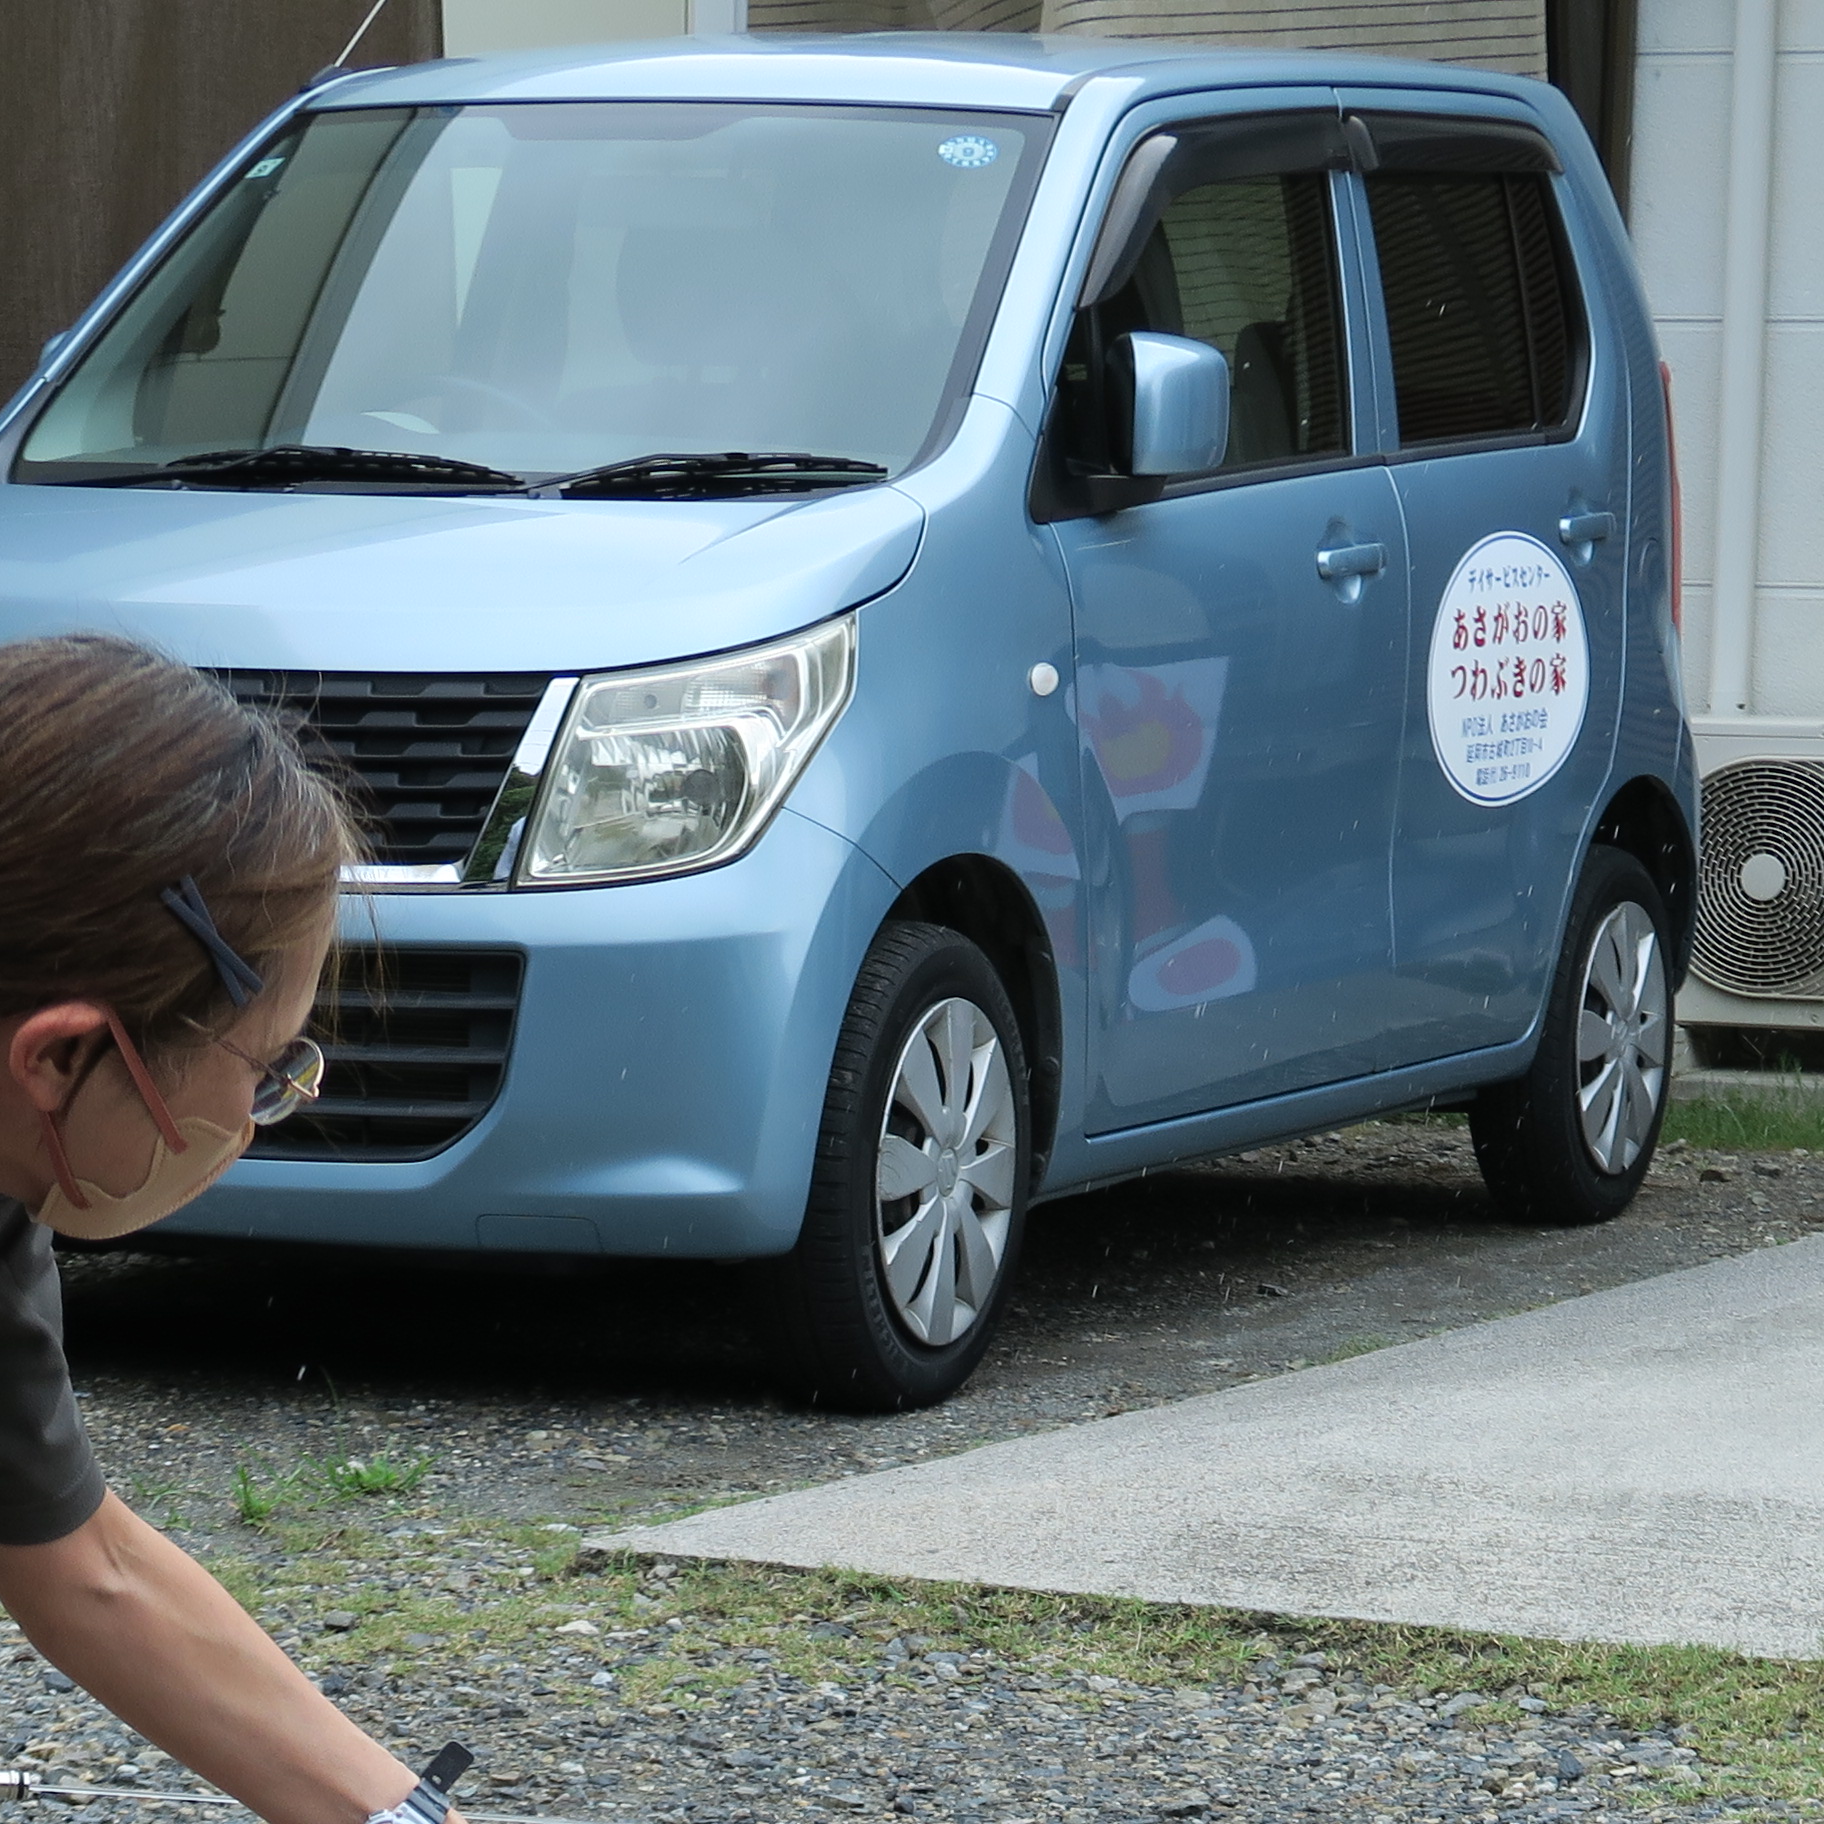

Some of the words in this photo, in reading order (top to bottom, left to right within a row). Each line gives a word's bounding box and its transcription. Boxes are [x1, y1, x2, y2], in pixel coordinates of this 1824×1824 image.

[1468, 564, 1551, 593] デイサービスセンター
[1453, 600, 1567, 651] あさがおの家
[1451, 652, 1566, 701] つわぶきの家
